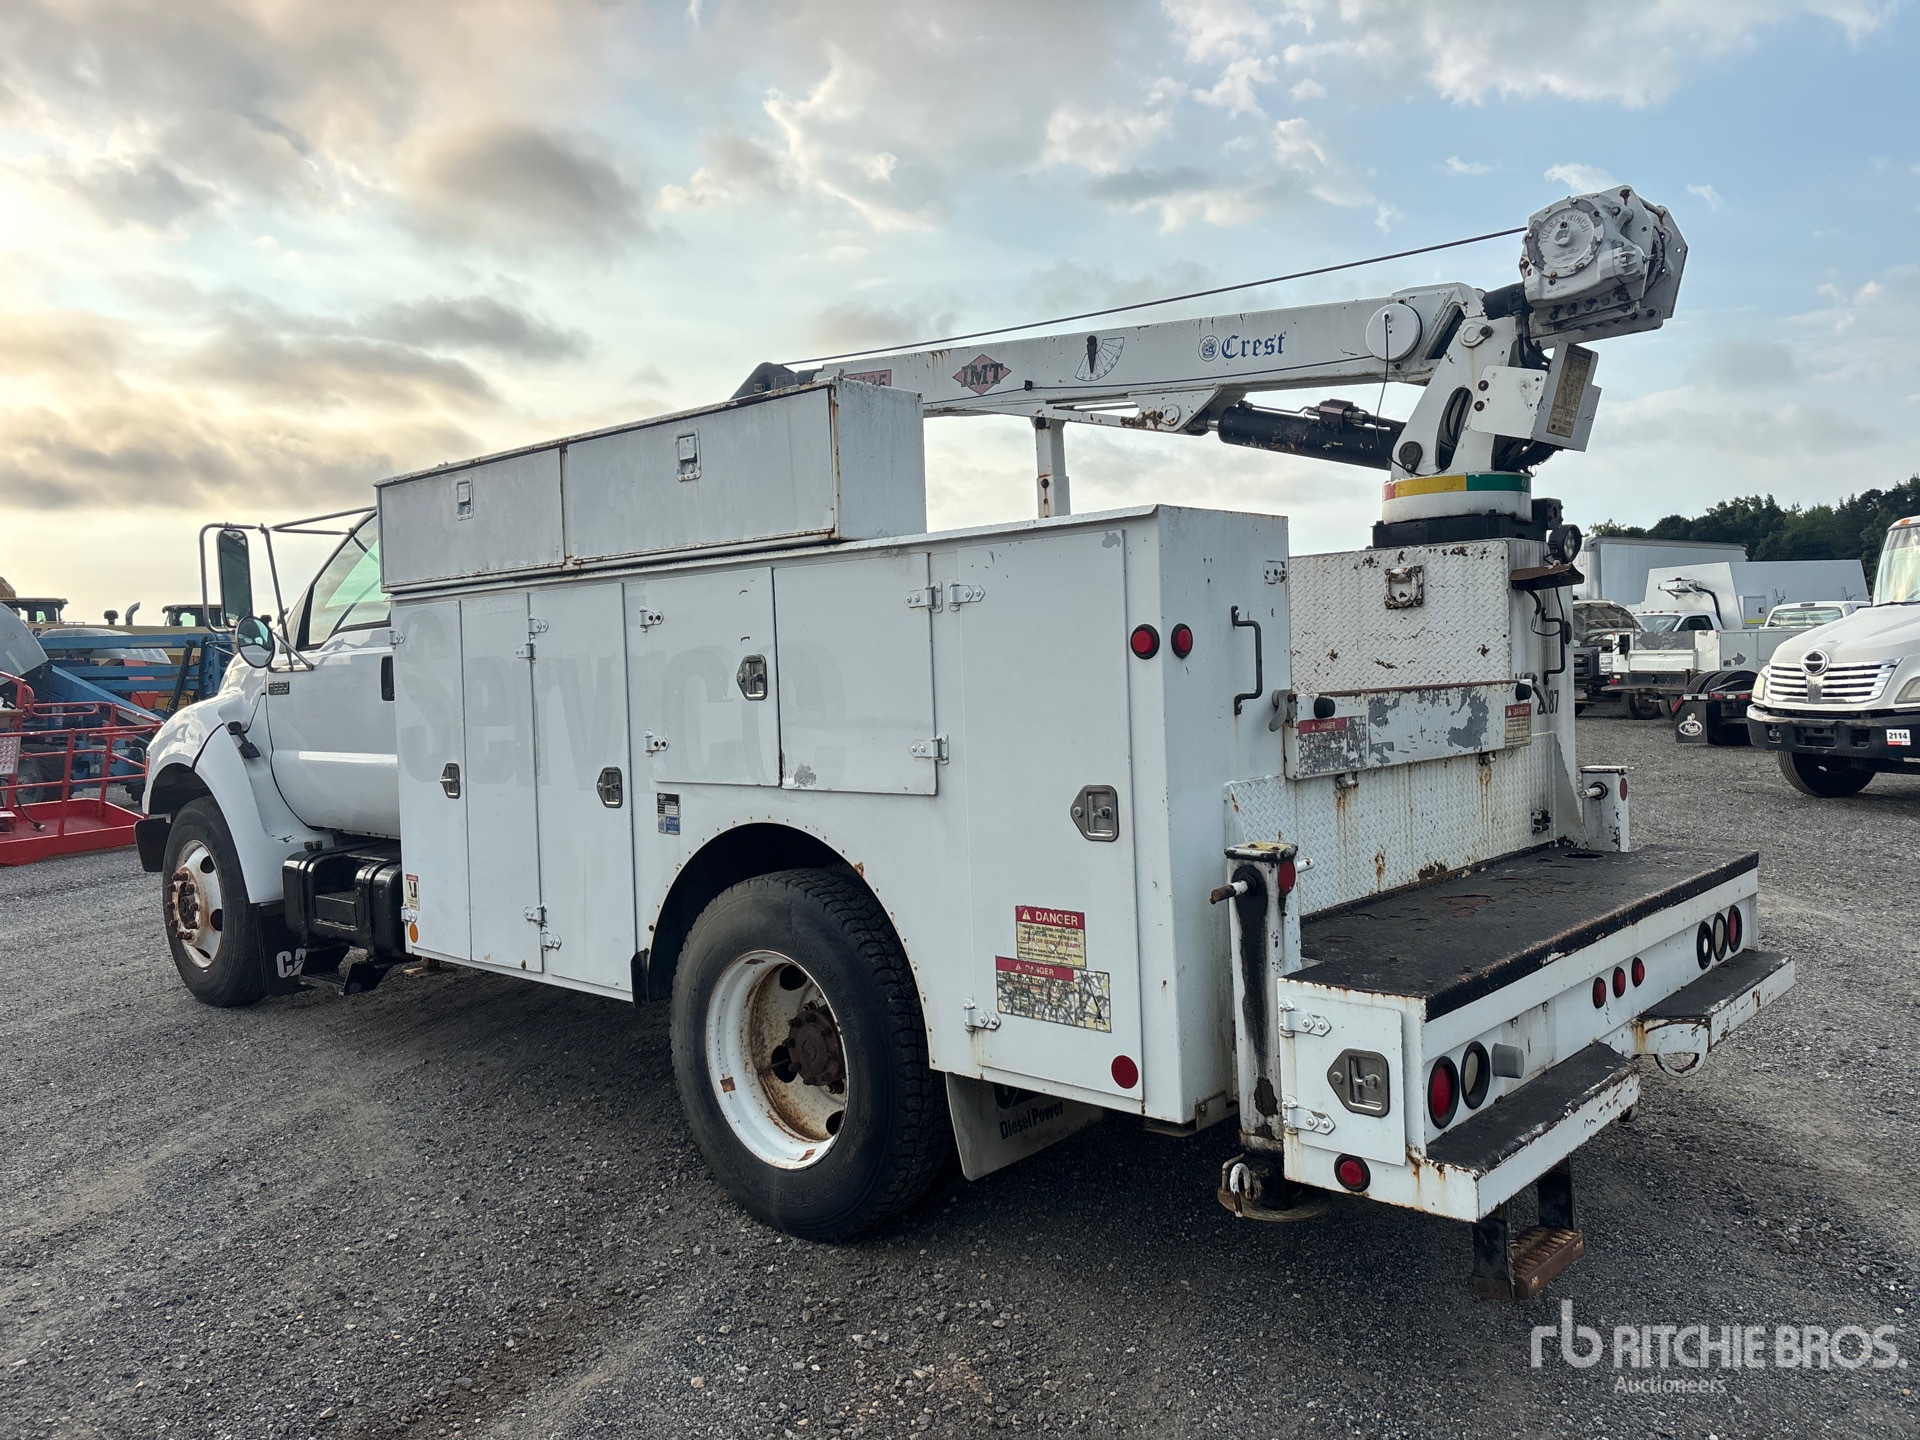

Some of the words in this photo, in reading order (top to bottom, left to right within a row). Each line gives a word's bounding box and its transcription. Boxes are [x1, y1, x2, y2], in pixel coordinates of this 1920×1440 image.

[1221, 332, 1285, 360] Crest
[960, 362, 1004, 388] IMT
[1888, 732, 1908, 740] 2114
[1035, 910, 1078, 926] DANGER
[1025, 964, 1054, 976] DANGER
[999, 1110, 1033, 1140] Diesel
[1032, 1101, 1065, 1127] Power
